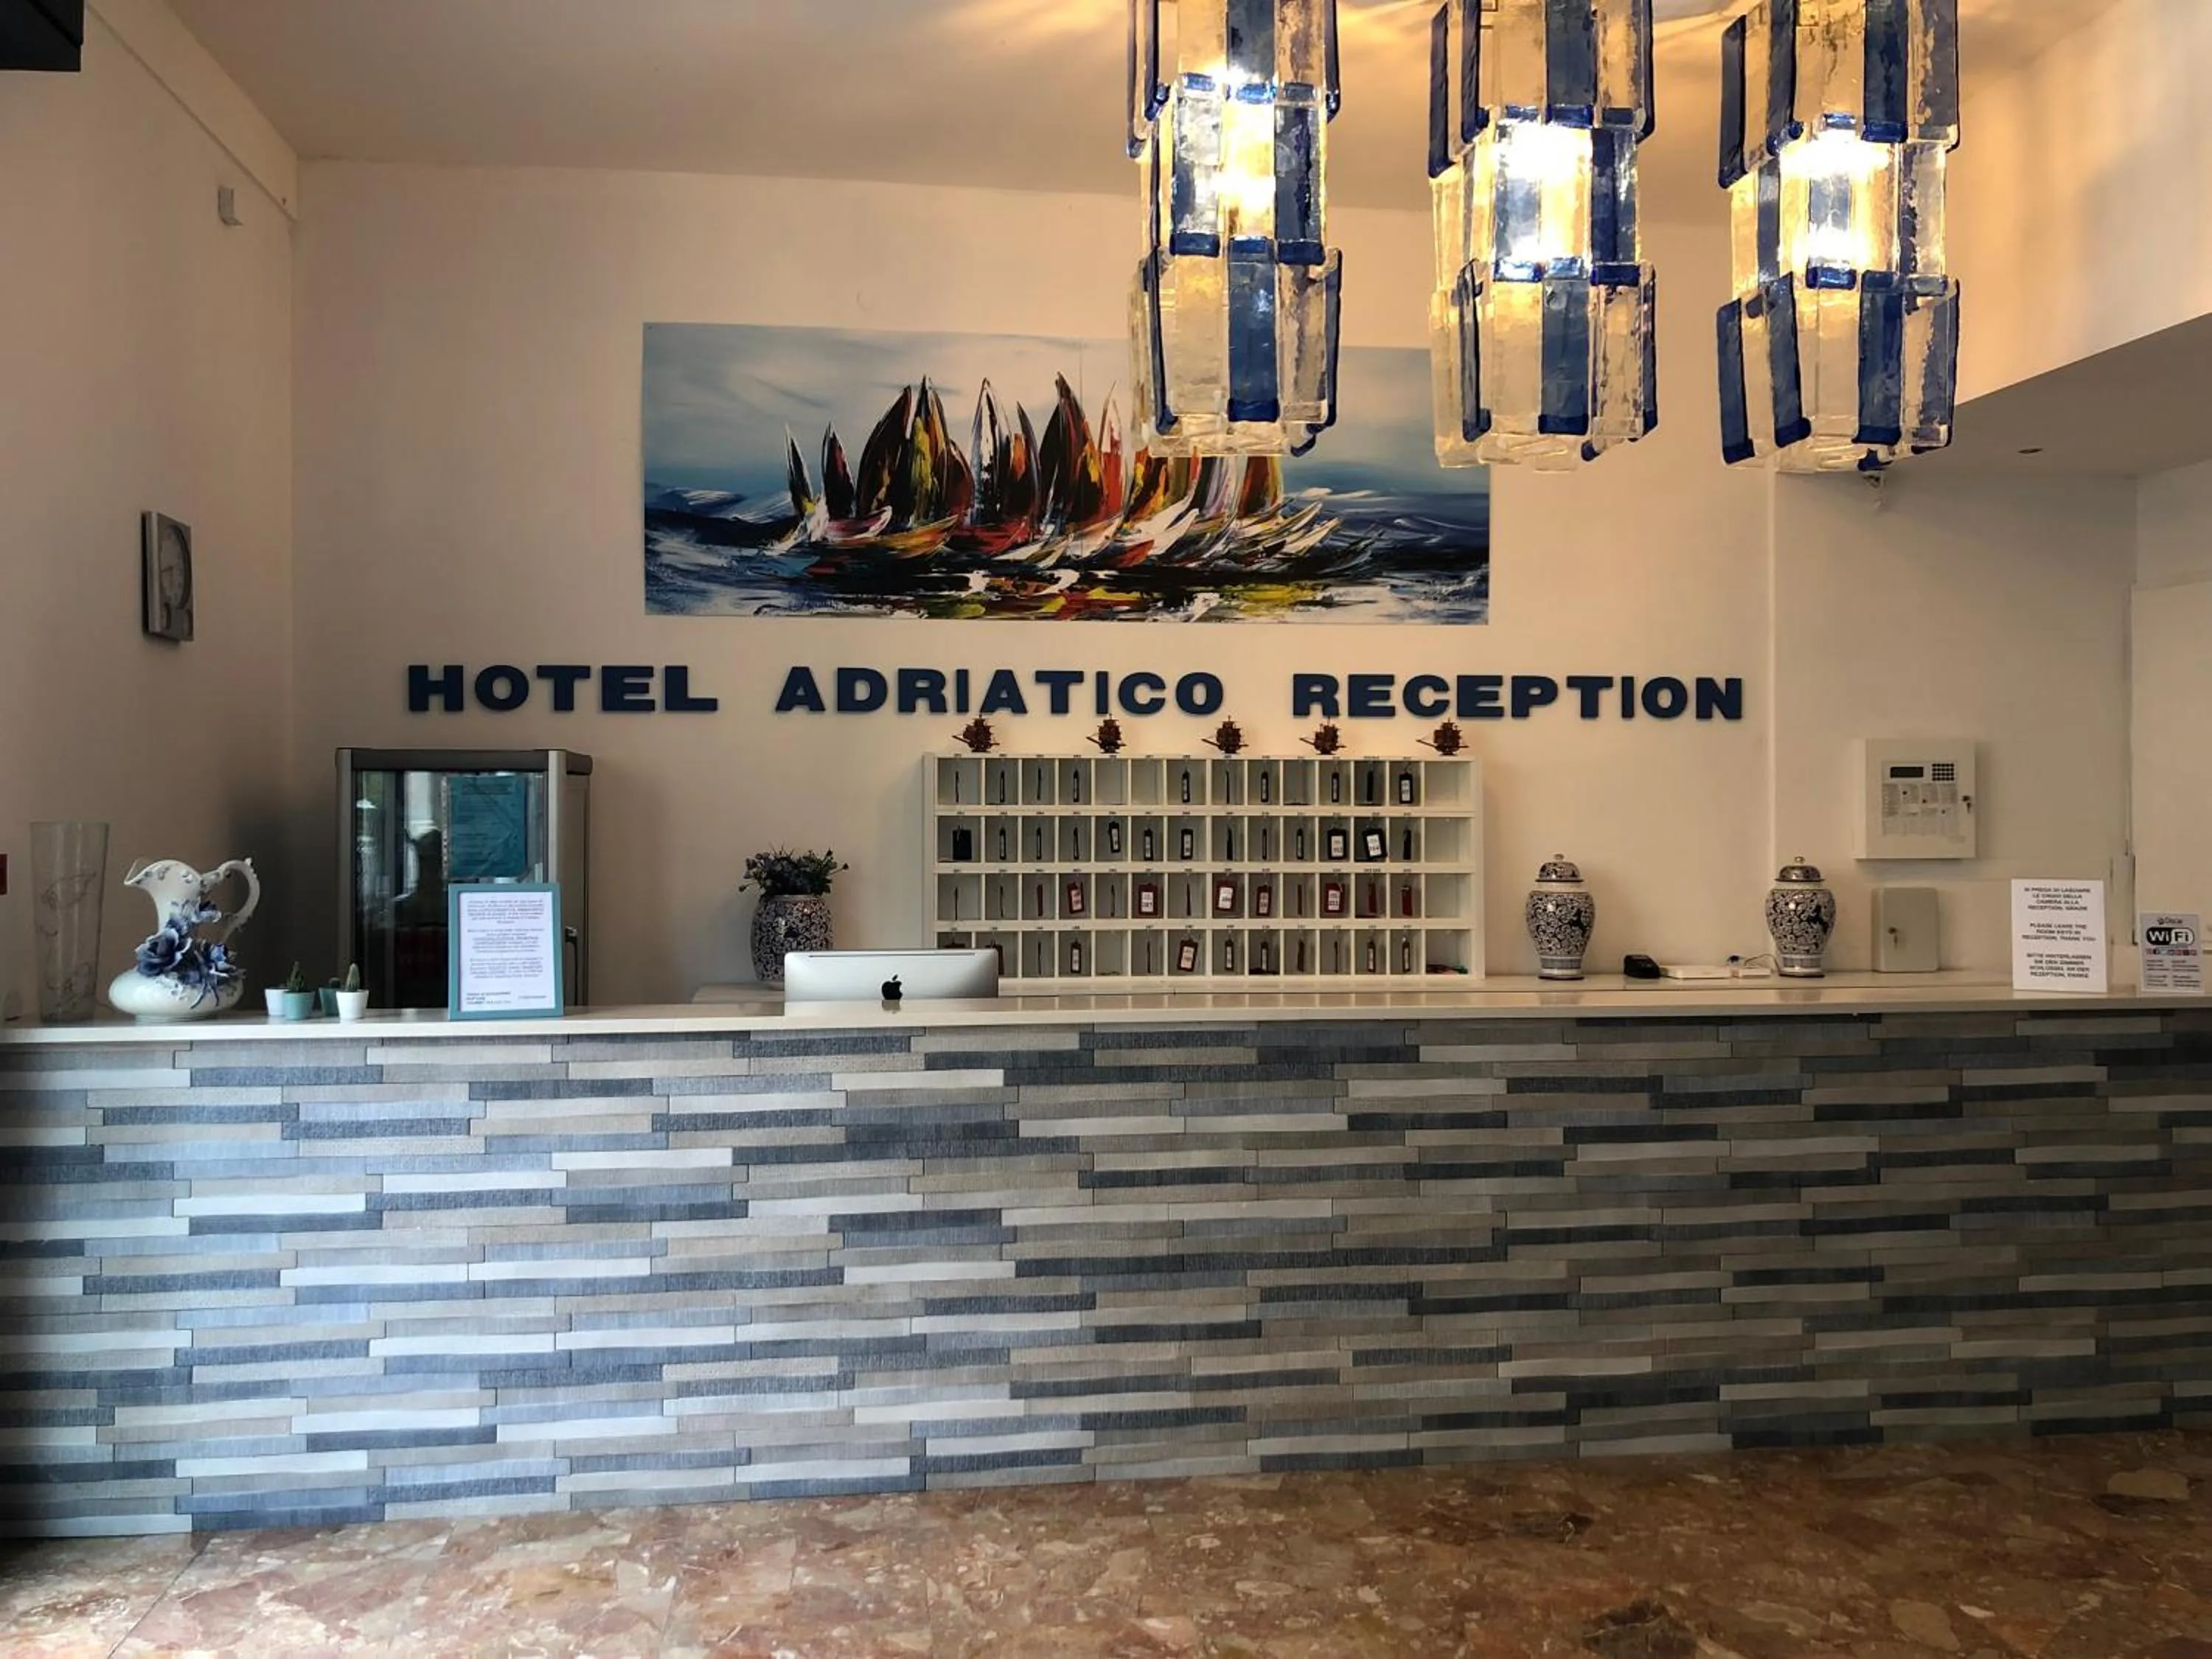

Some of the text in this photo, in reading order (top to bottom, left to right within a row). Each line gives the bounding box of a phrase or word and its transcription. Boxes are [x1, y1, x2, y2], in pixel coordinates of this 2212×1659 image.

[406, 665, 1743, 720] HOTEL ADRIATICO RECEPTION
